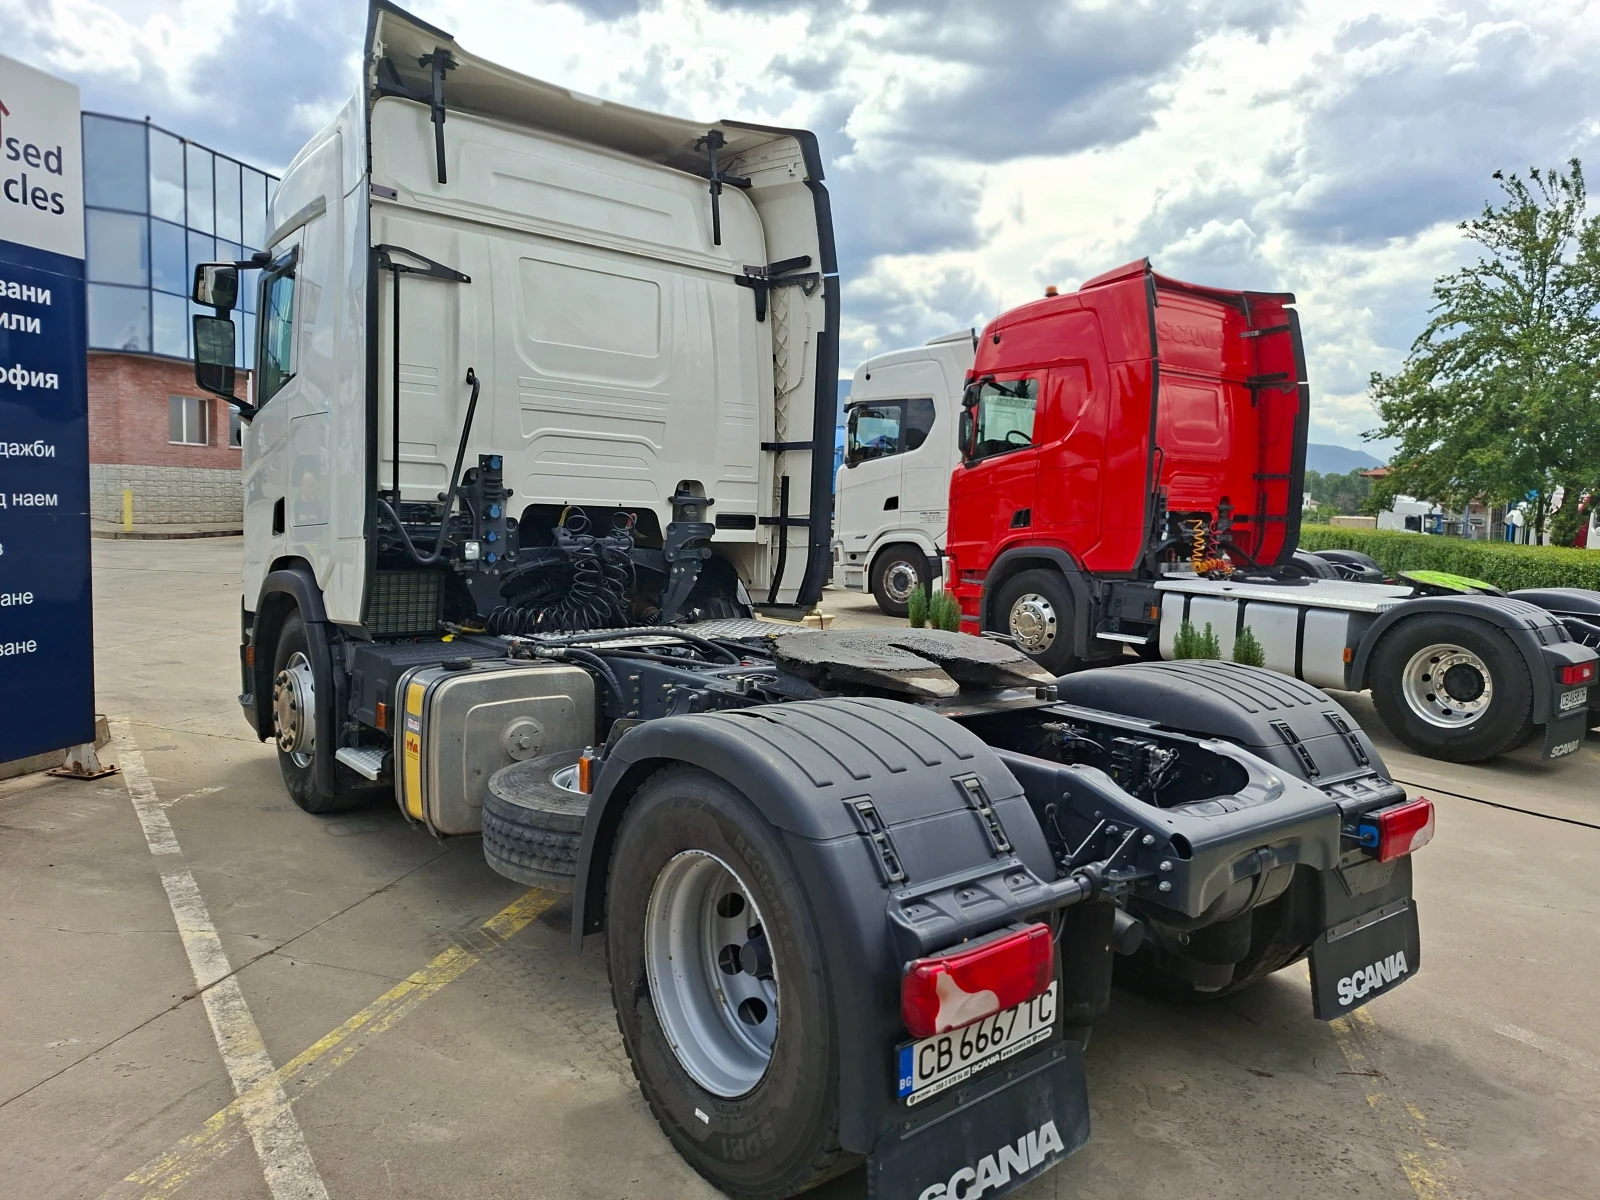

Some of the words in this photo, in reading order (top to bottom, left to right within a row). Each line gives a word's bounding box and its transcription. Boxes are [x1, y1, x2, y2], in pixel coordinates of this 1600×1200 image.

[1, 137, 63, 176] sed
[3, 172, 65, 215] cles
[12, 493, 58, 507] наем
[1550, 739, 1580, 758] SCANIA
[1337, 950, 1409, 1006] SCANIA
[918, 1036, 953, 1081] CB
[959, 1006, 1019, 1061] 6667
[971, 1054, 1000, 1074] SCANIA
[899, 1075, 912, 1090] BG
